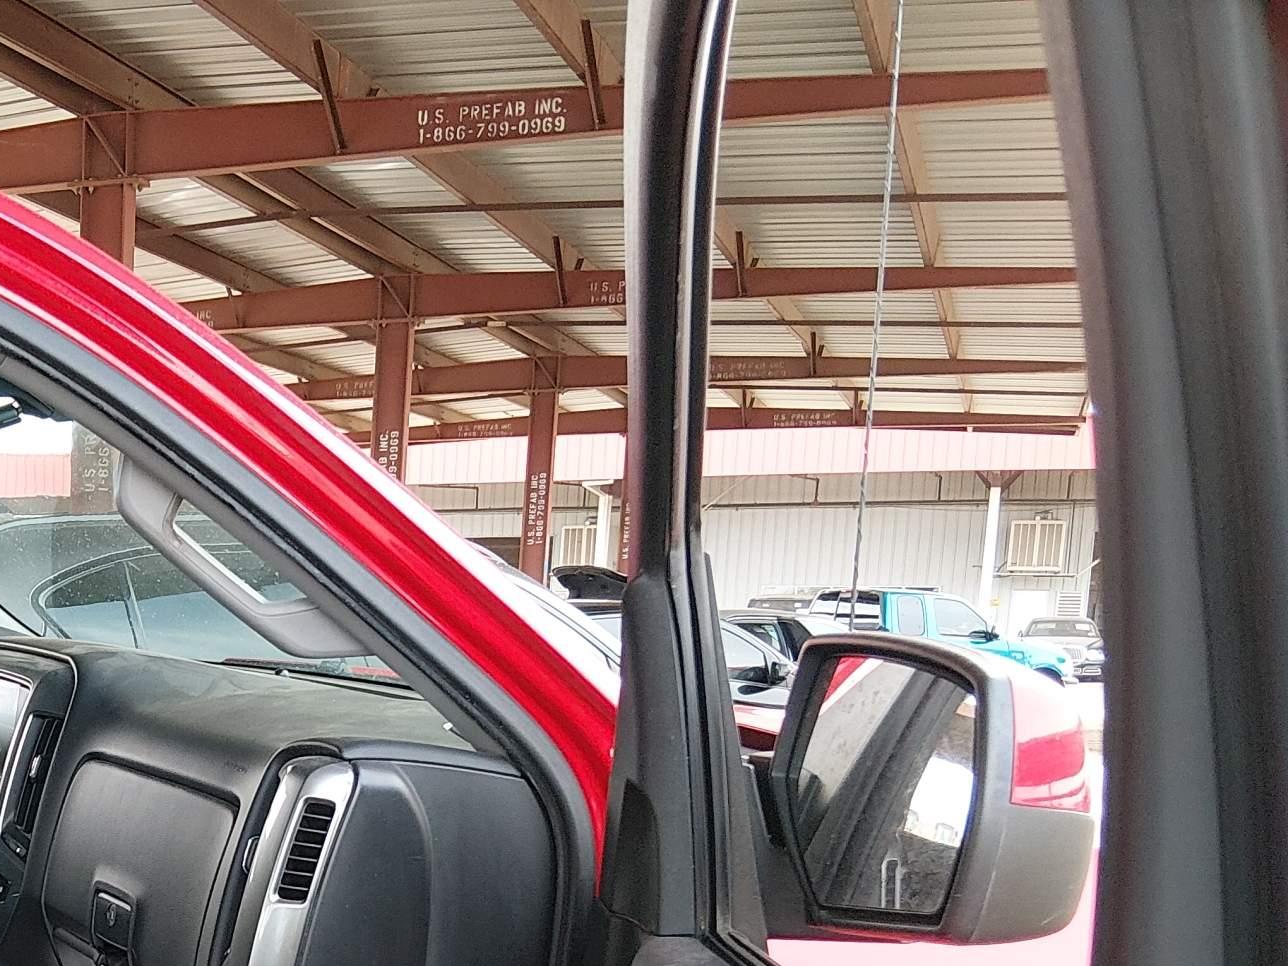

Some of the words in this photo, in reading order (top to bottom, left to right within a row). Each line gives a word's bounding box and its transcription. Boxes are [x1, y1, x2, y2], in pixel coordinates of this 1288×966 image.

[418, 108, 449, 126] U.S.
[459, 100, 526, 122] PREFAB
[535, 97, 567, 115] INC.
[418, 116, 566, 145] 1-866-799-0969
[527, 491, 538, 525] PREFAB
